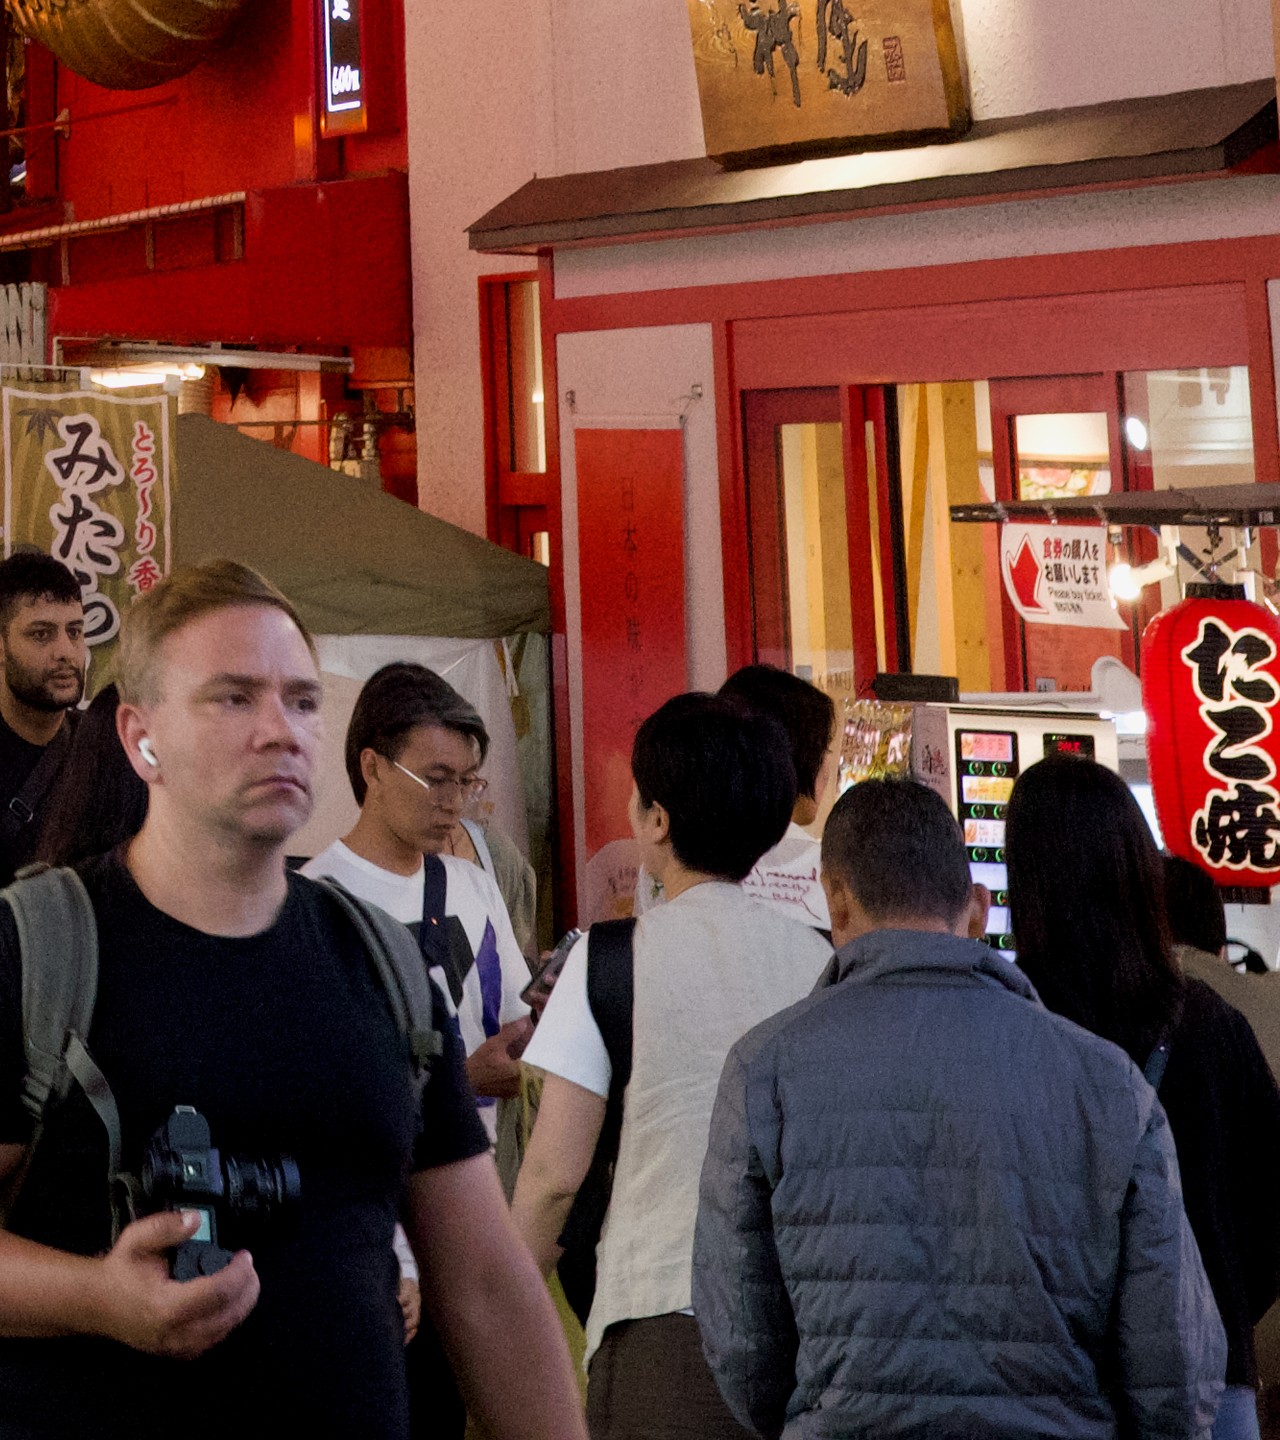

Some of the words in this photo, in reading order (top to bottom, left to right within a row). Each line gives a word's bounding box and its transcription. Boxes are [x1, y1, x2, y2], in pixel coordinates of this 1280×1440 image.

[1044, 562, 1100, 586] お願いします
